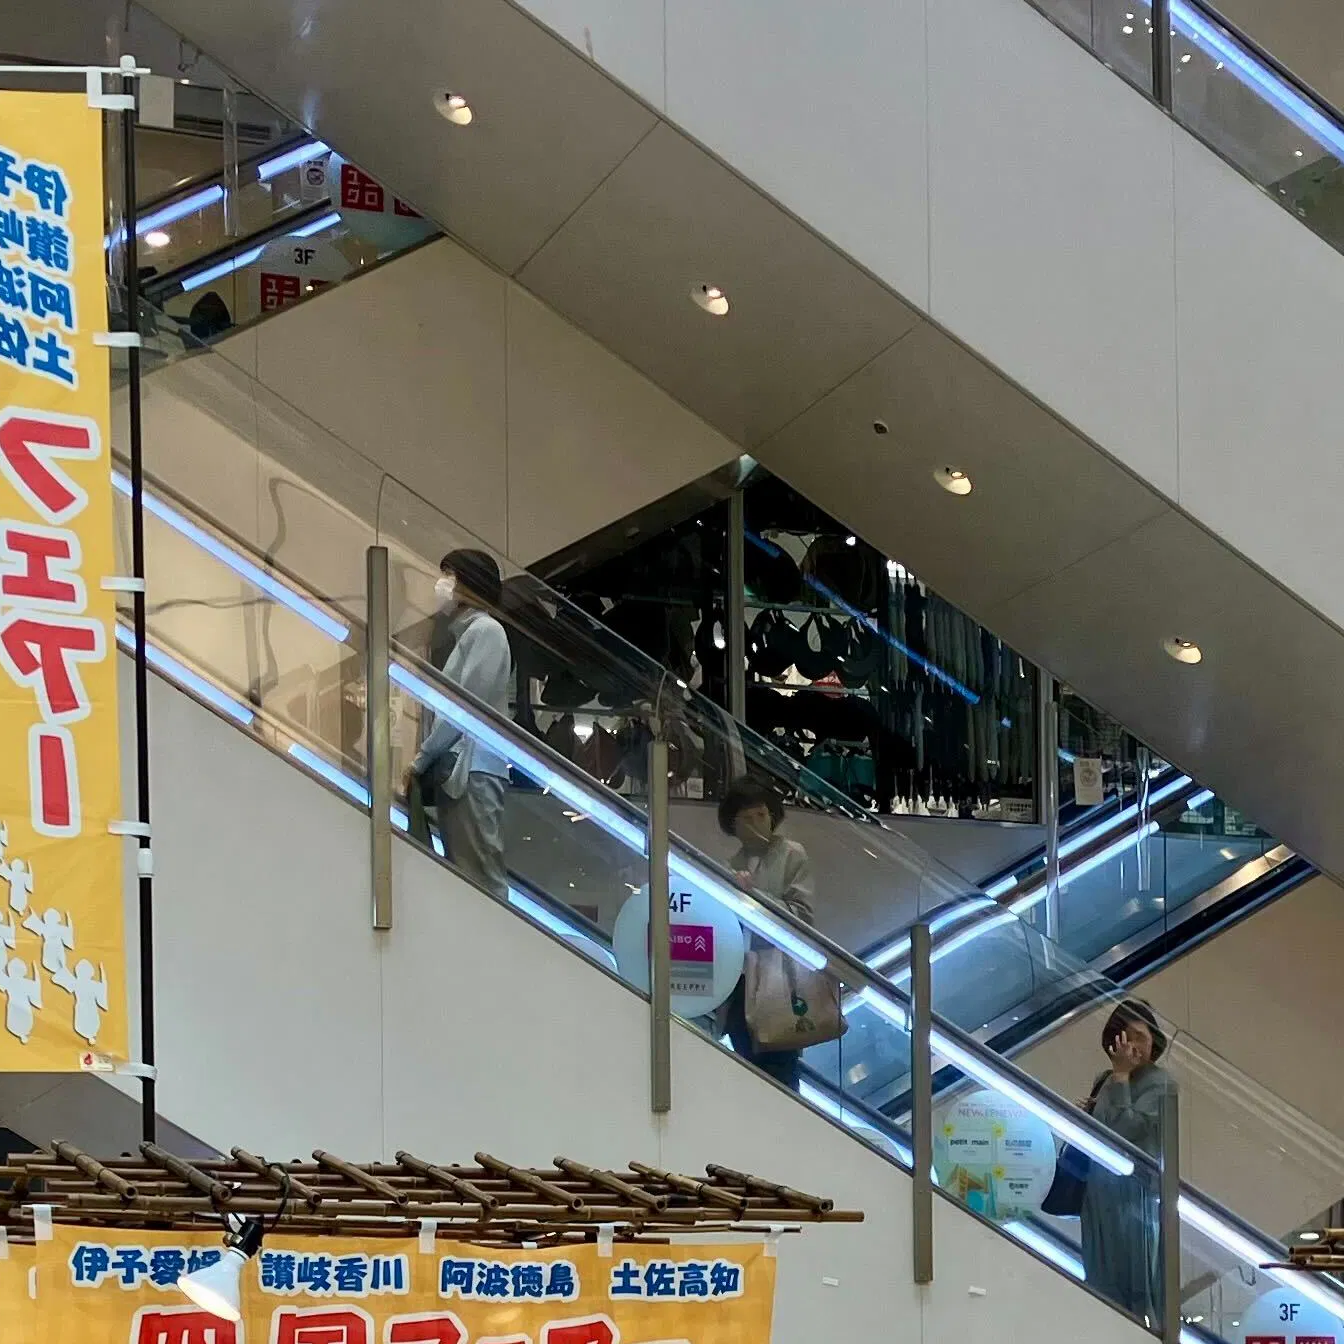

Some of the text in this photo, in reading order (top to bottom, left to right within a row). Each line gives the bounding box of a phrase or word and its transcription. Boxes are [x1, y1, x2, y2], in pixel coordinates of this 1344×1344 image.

[294, 249, 315, 265] 3F
[262, 1254, 405, 1293] 讃岐香川
[441, 1259, 575, 1298] 阿波徳島
[611, 1262, 741, 1297] 土佐高知
[1279, 1303, 1301, 1322] 3F
